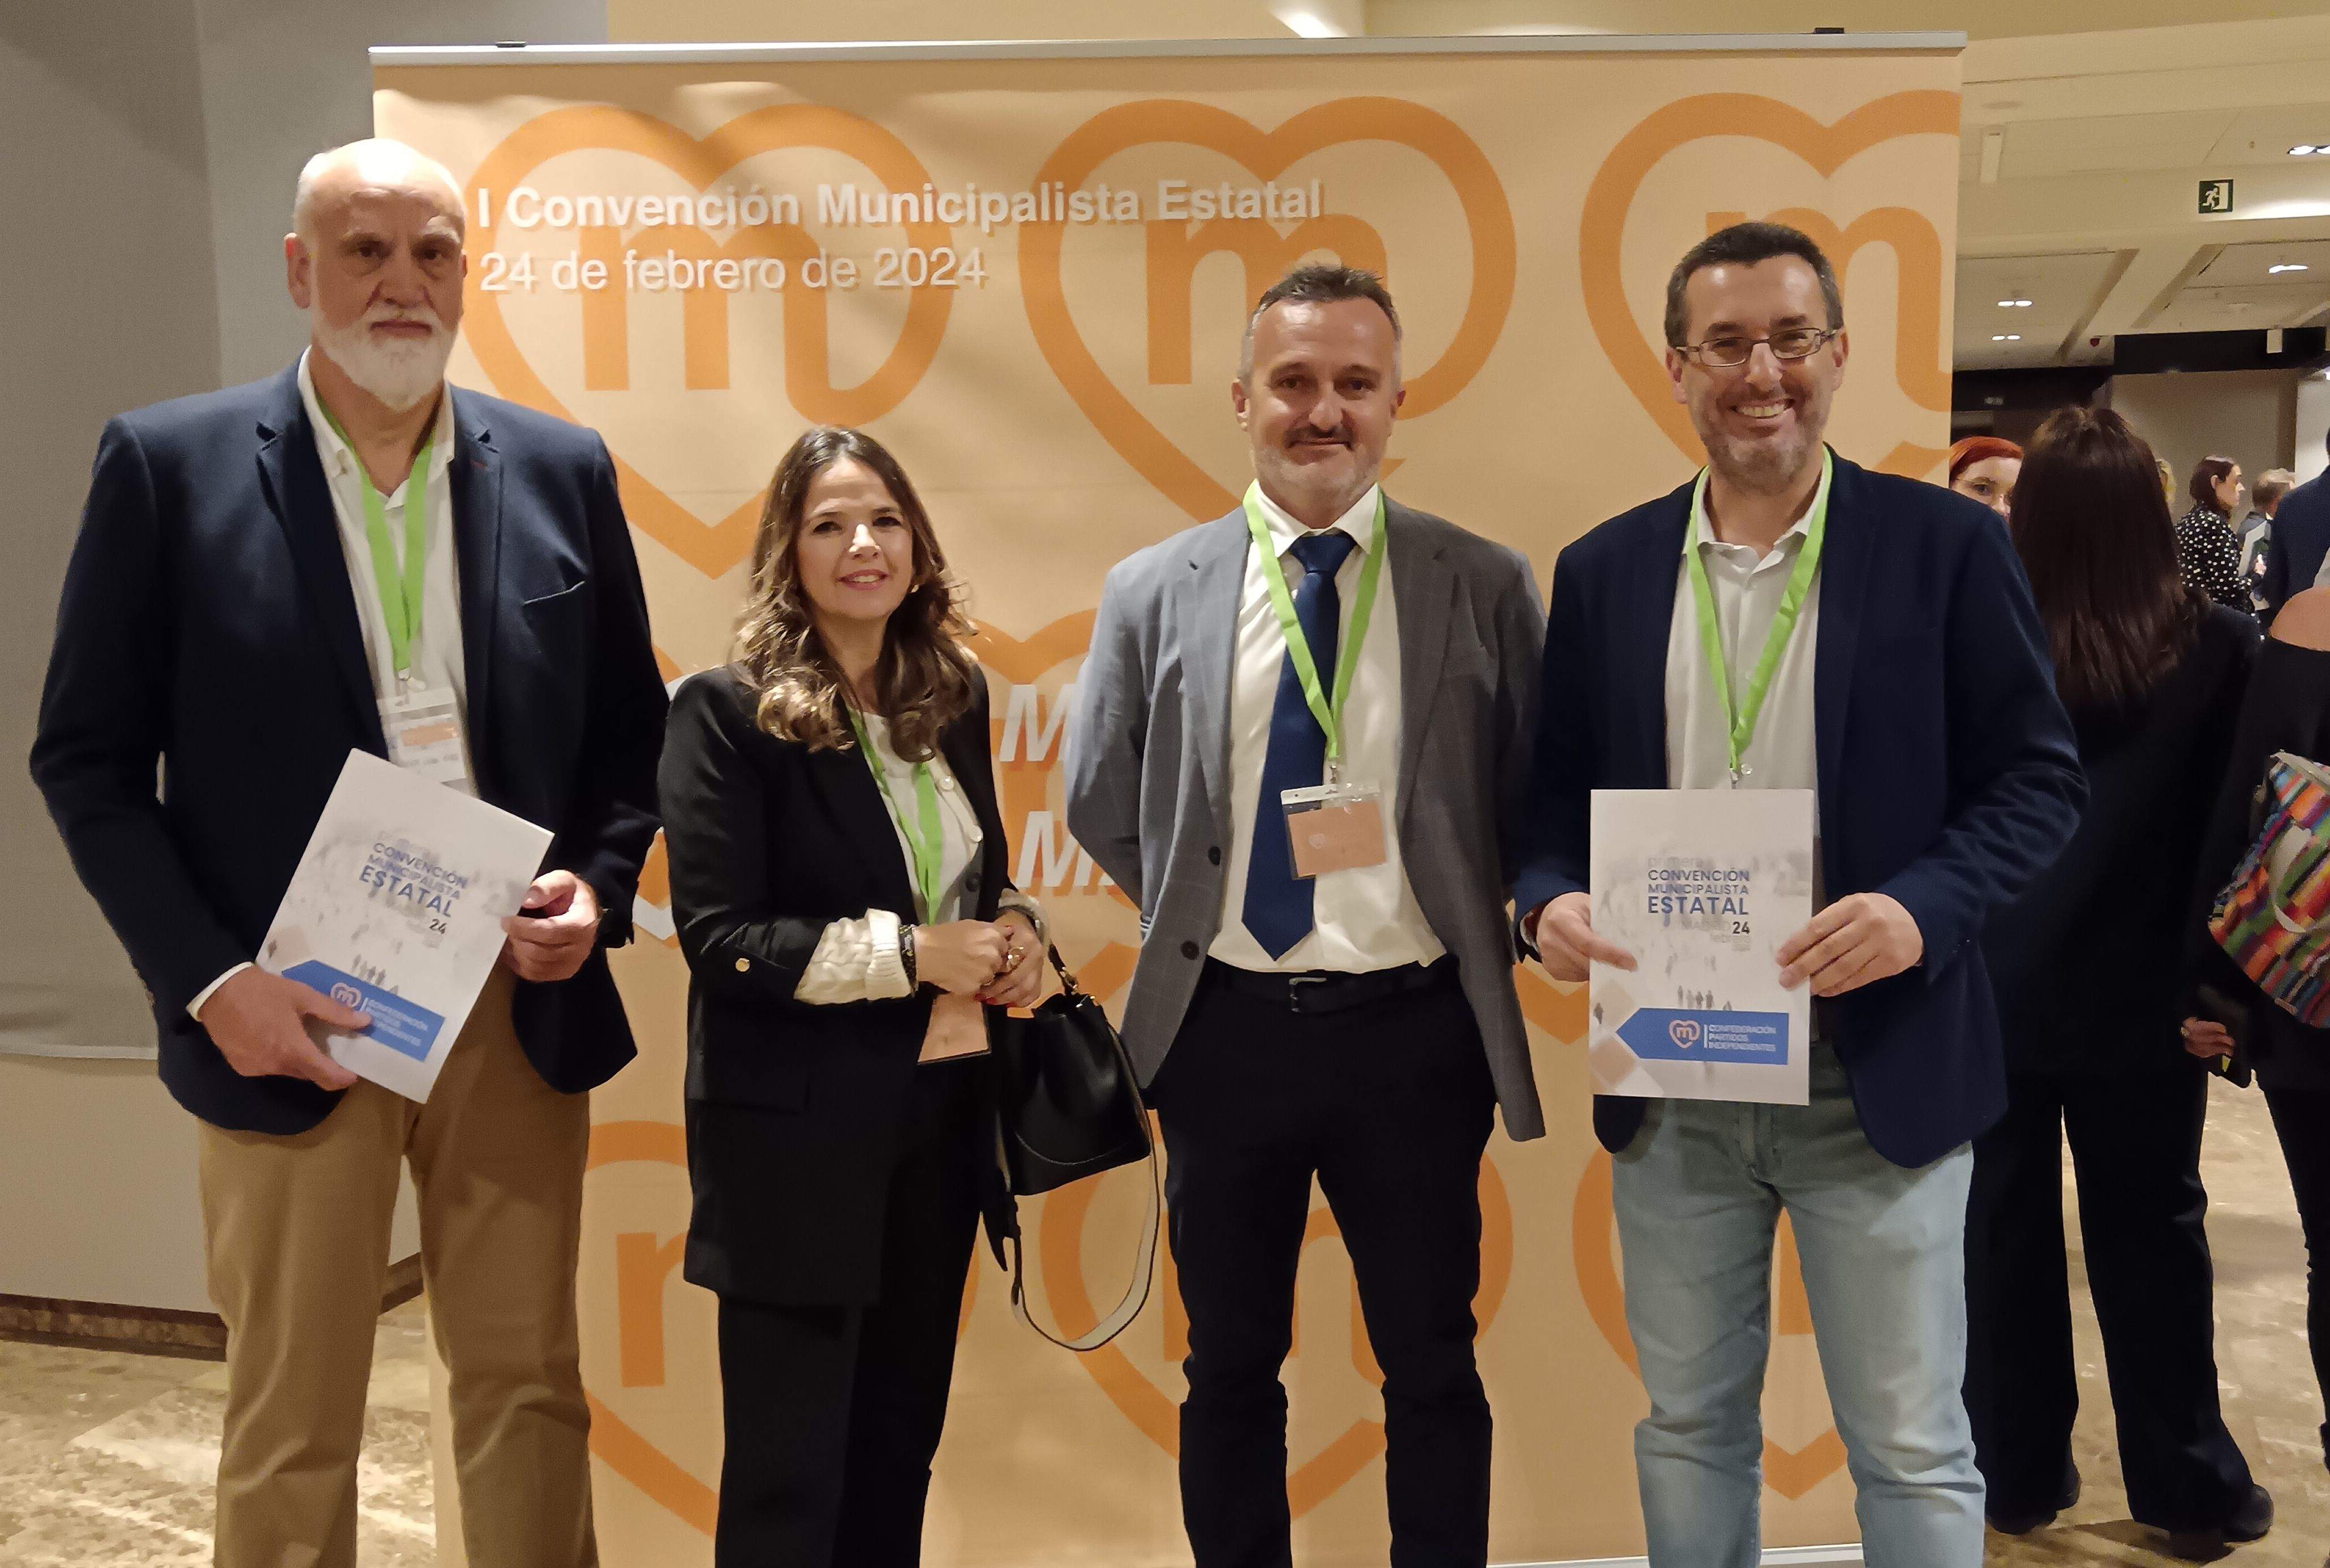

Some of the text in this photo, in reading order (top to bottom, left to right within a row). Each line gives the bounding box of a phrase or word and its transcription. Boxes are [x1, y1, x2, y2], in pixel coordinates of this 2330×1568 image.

[478, 179, 1319, 232] I Convención Municipalista Estatal
[479, 247, 987, 291] 24 de febrero de 2024
[1648, 867, 1750, 882] CONVENCIÓN
[359, 864, 452, 917] ESTATAL
[1648, 884, 1749, 895] MUNICIPALISTA
[1648, 896, 1749, 915] ESTATAL
[429, 919, 448, 934] 24
[1732, 921, 1750, 934] 24
